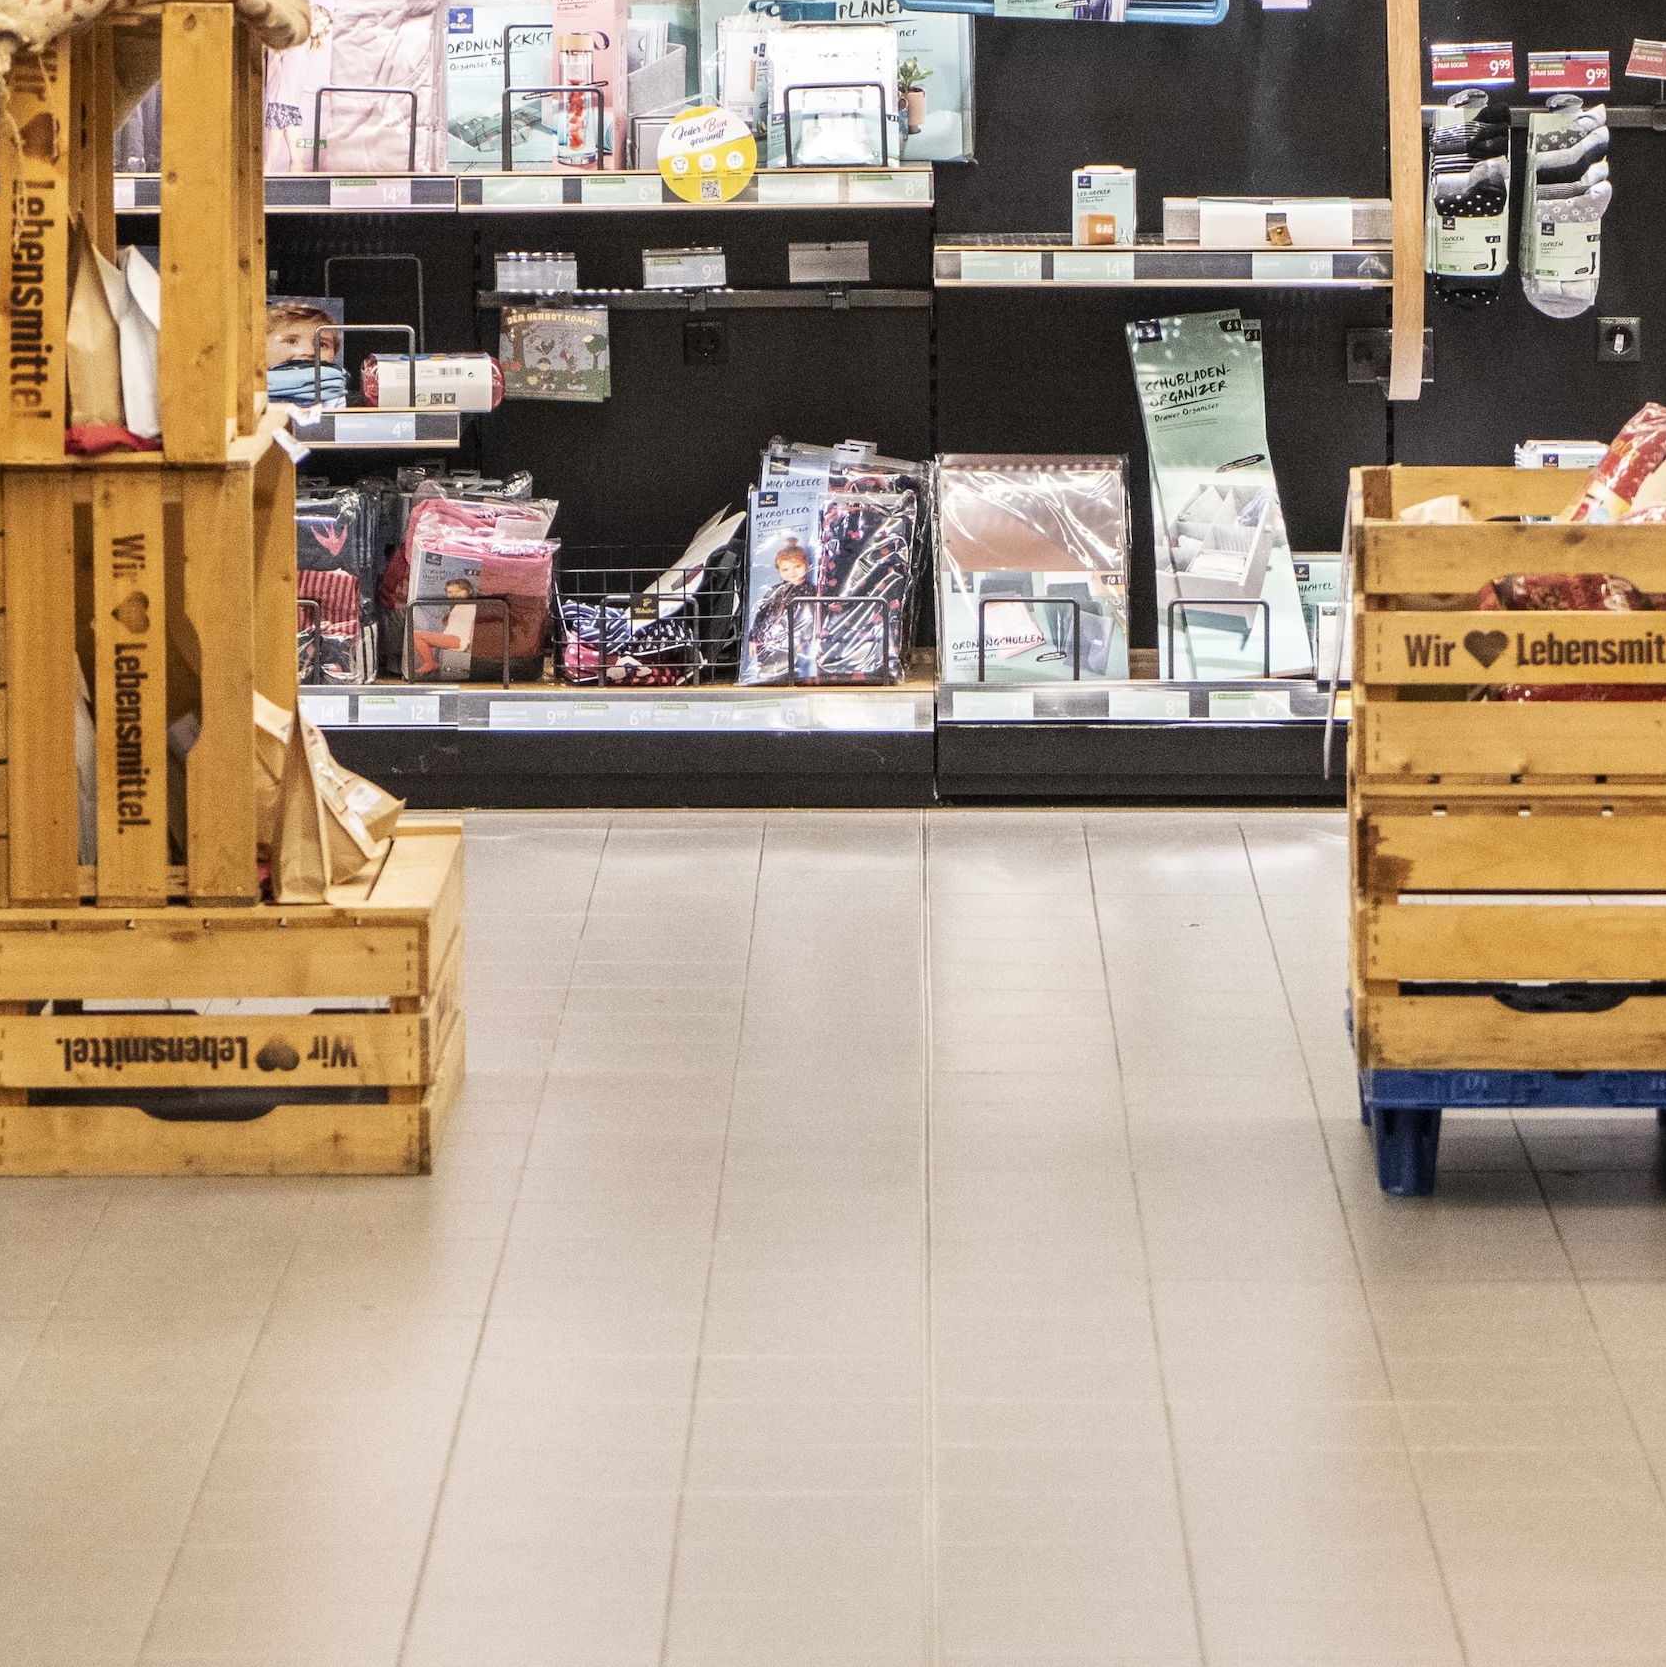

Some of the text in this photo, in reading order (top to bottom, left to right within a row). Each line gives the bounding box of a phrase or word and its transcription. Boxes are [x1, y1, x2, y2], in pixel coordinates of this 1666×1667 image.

[671, 117, 728, 142] Jeder Bon
[689, 129, 726, 149] gewinnt!
[506, 314, 525, 326] DER
[526, 312, 563, 322] HERBST
[1144, 362, 1232, 395] SCHUBLADEN-
[1150, 379, 1228, 408] ORGANIZER
[1154, 402, 1220, 423] Drawer Organiser
[1404, 634, 1455, 668] Wir
[111, 533, 152, 836] Wir Lebensmittel.
[55, 1035, 358, 1073] Wir Lebensmittel.
